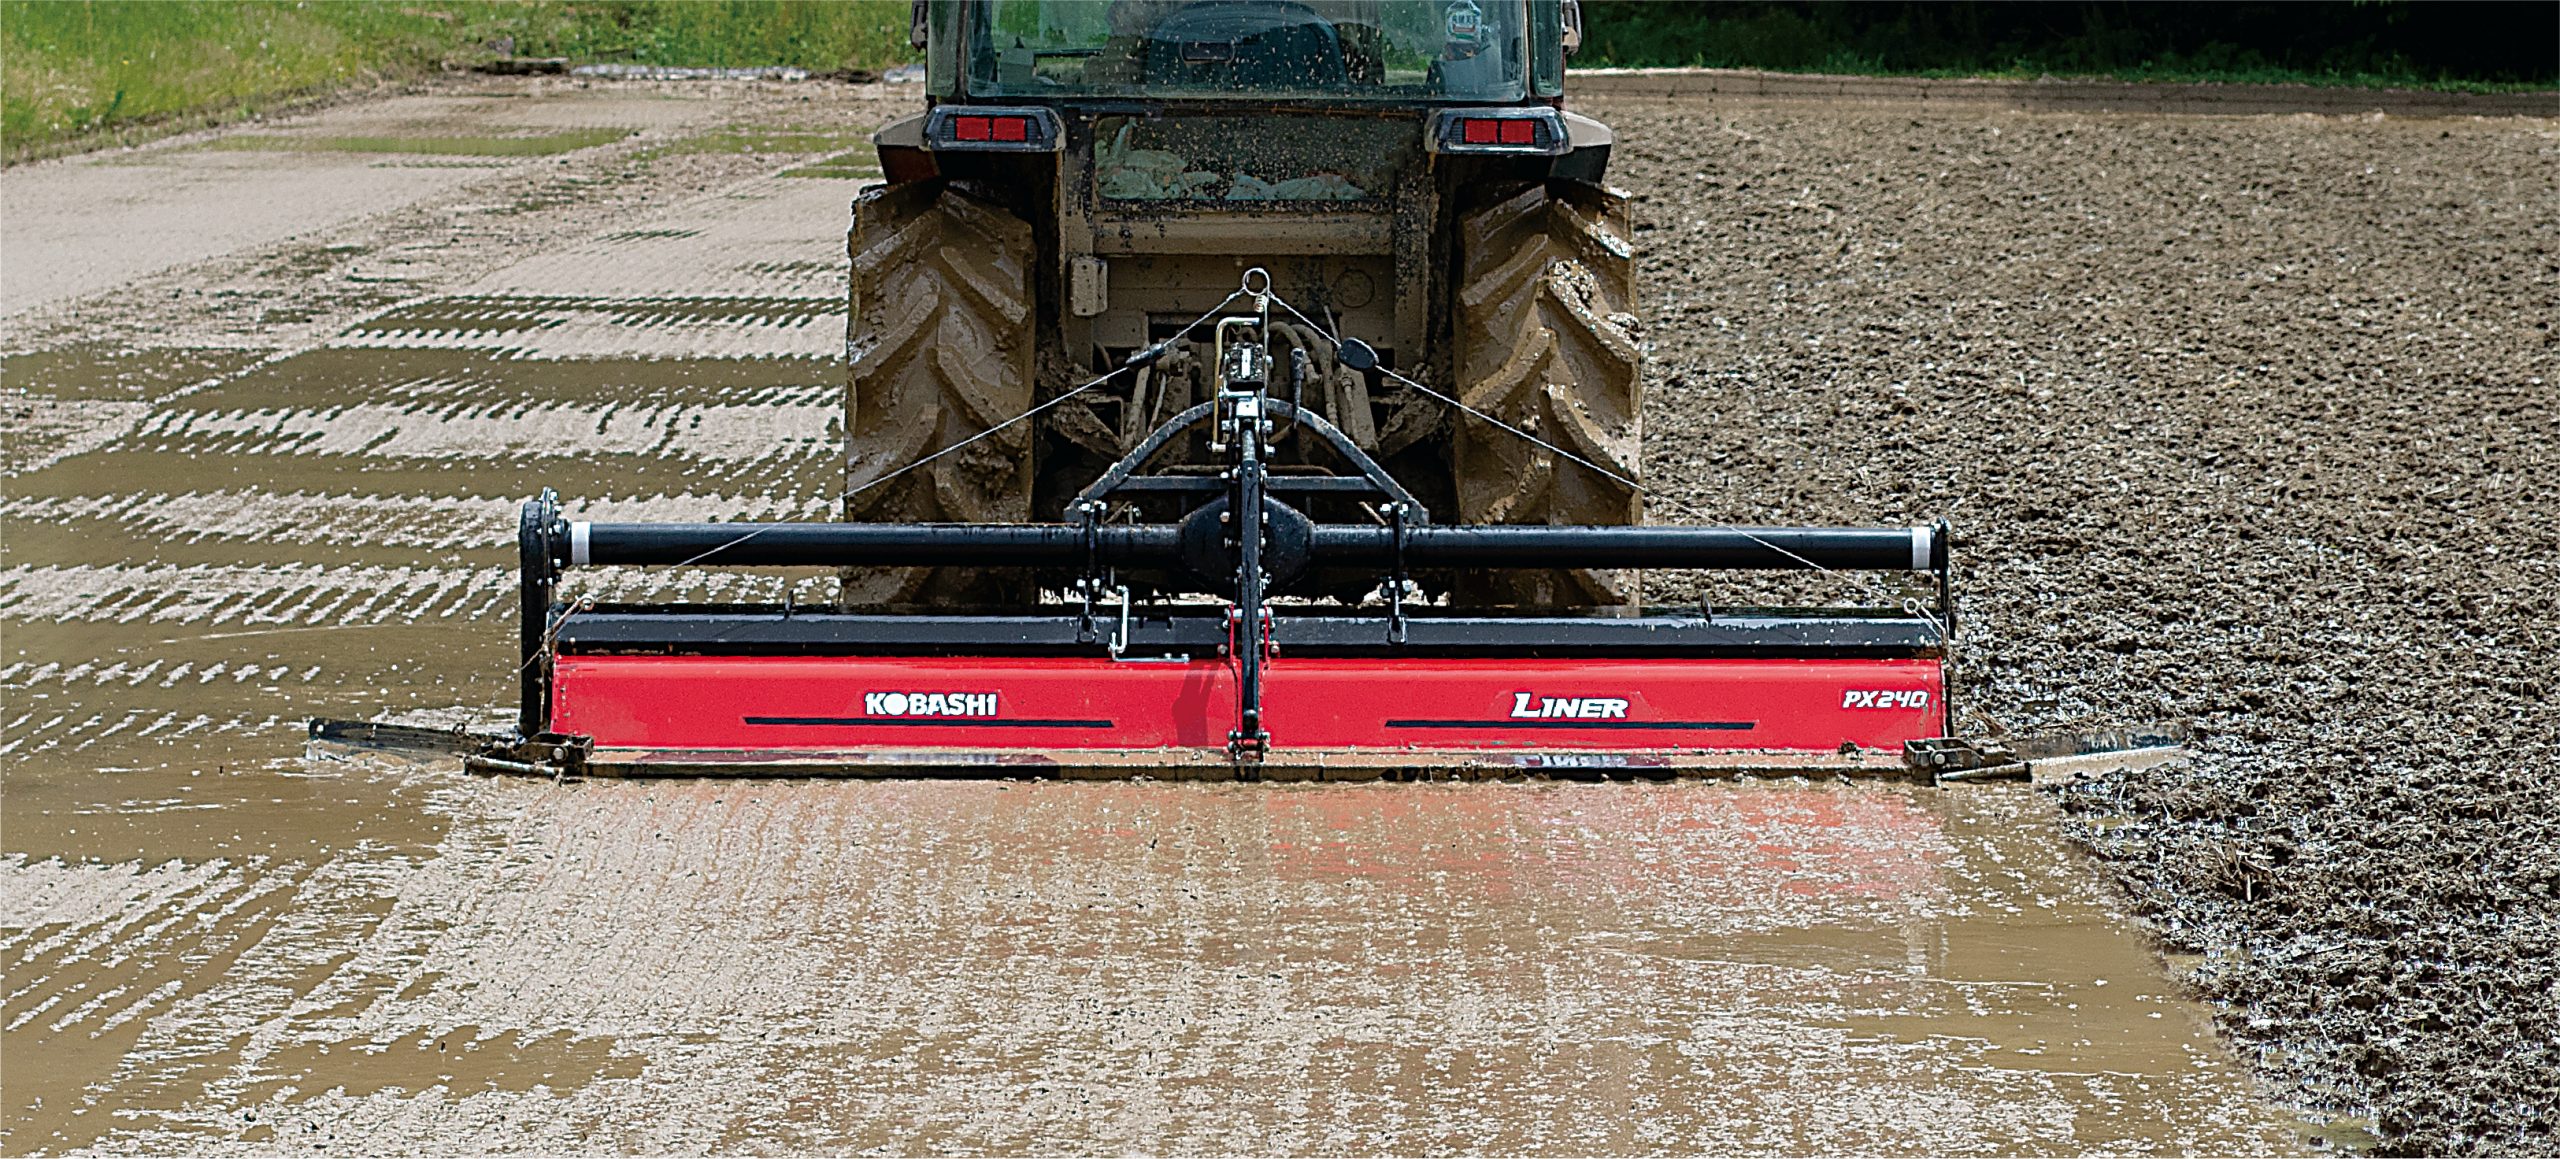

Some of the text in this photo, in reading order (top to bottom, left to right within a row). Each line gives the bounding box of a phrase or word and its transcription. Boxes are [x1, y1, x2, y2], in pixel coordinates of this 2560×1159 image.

[864, 692, 998, 716] KOBASHI
[1510, 692, 1629, 718] LINER
[1841, 690, 1929, 709] PX240
